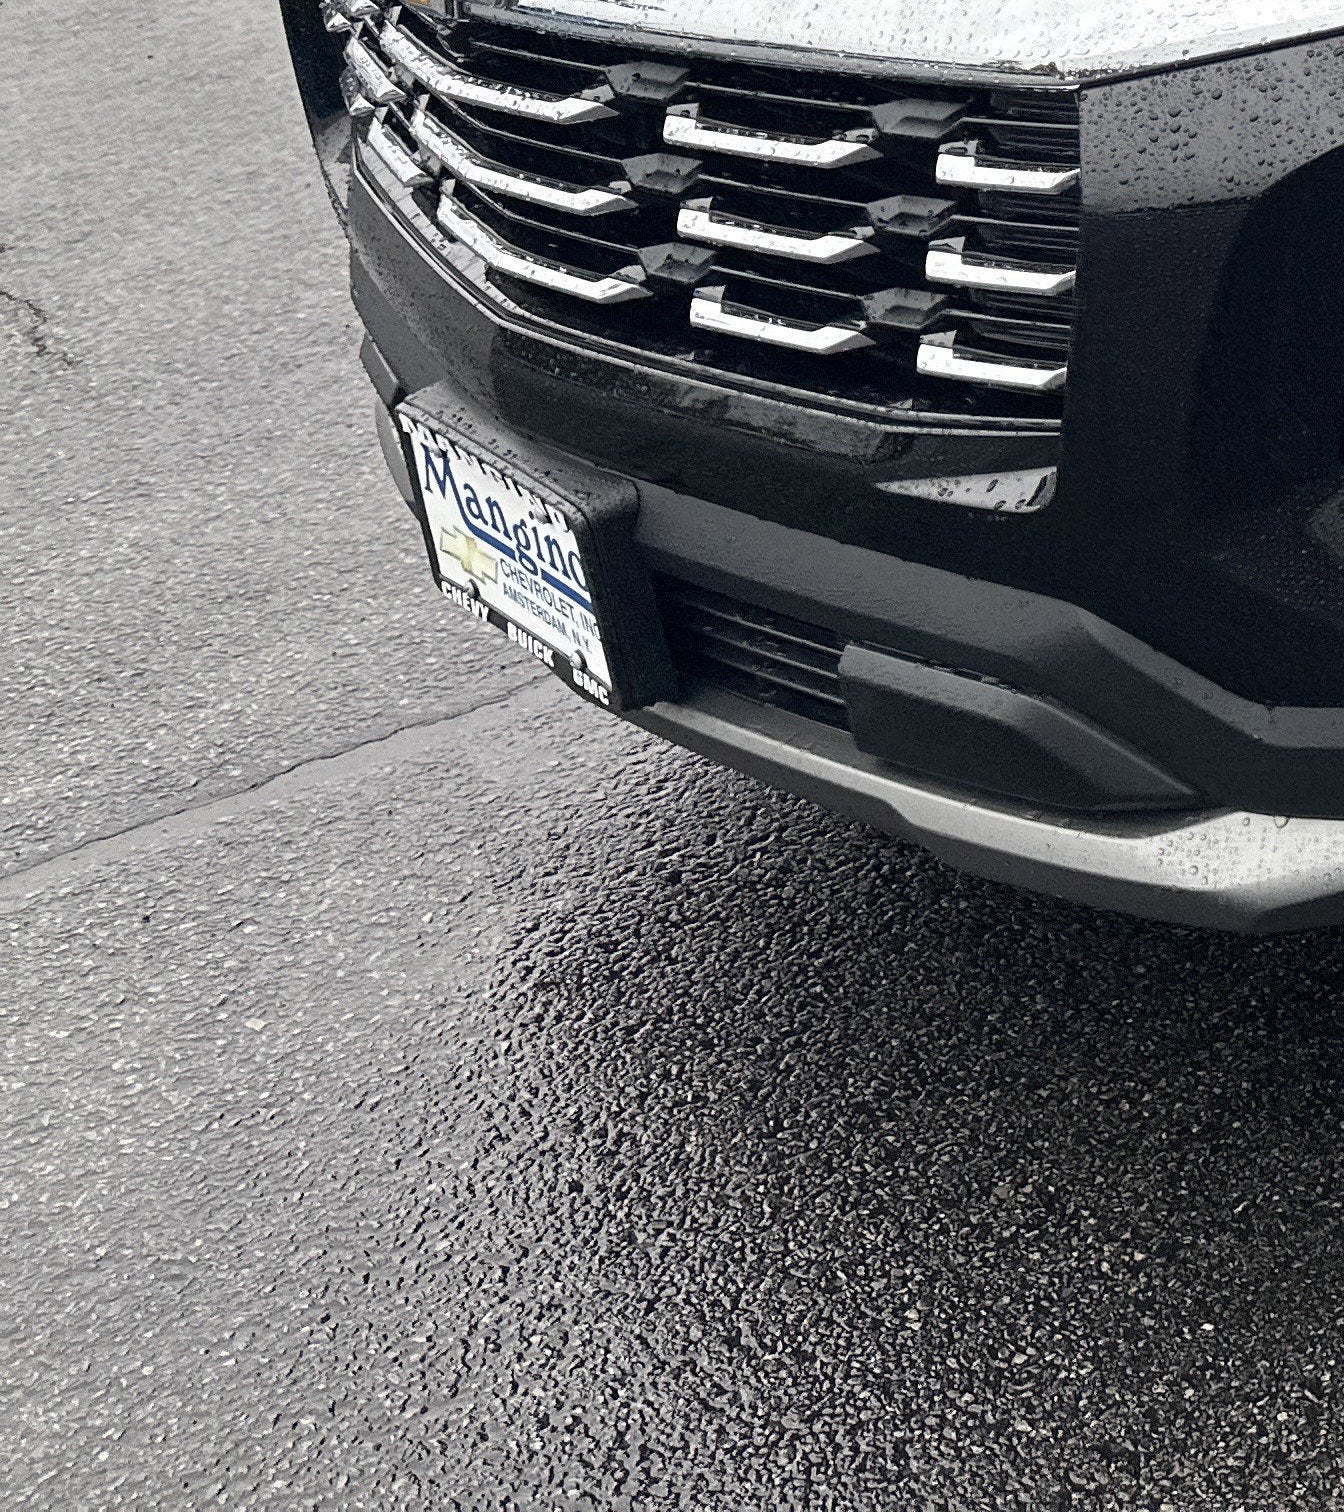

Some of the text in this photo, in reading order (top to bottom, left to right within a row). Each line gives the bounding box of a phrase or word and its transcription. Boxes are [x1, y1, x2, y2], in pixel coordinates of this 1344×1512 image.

[421, 440, 590, 590] Mangino
[441, 580, 610, 706] CHEVY BUICK GMC
